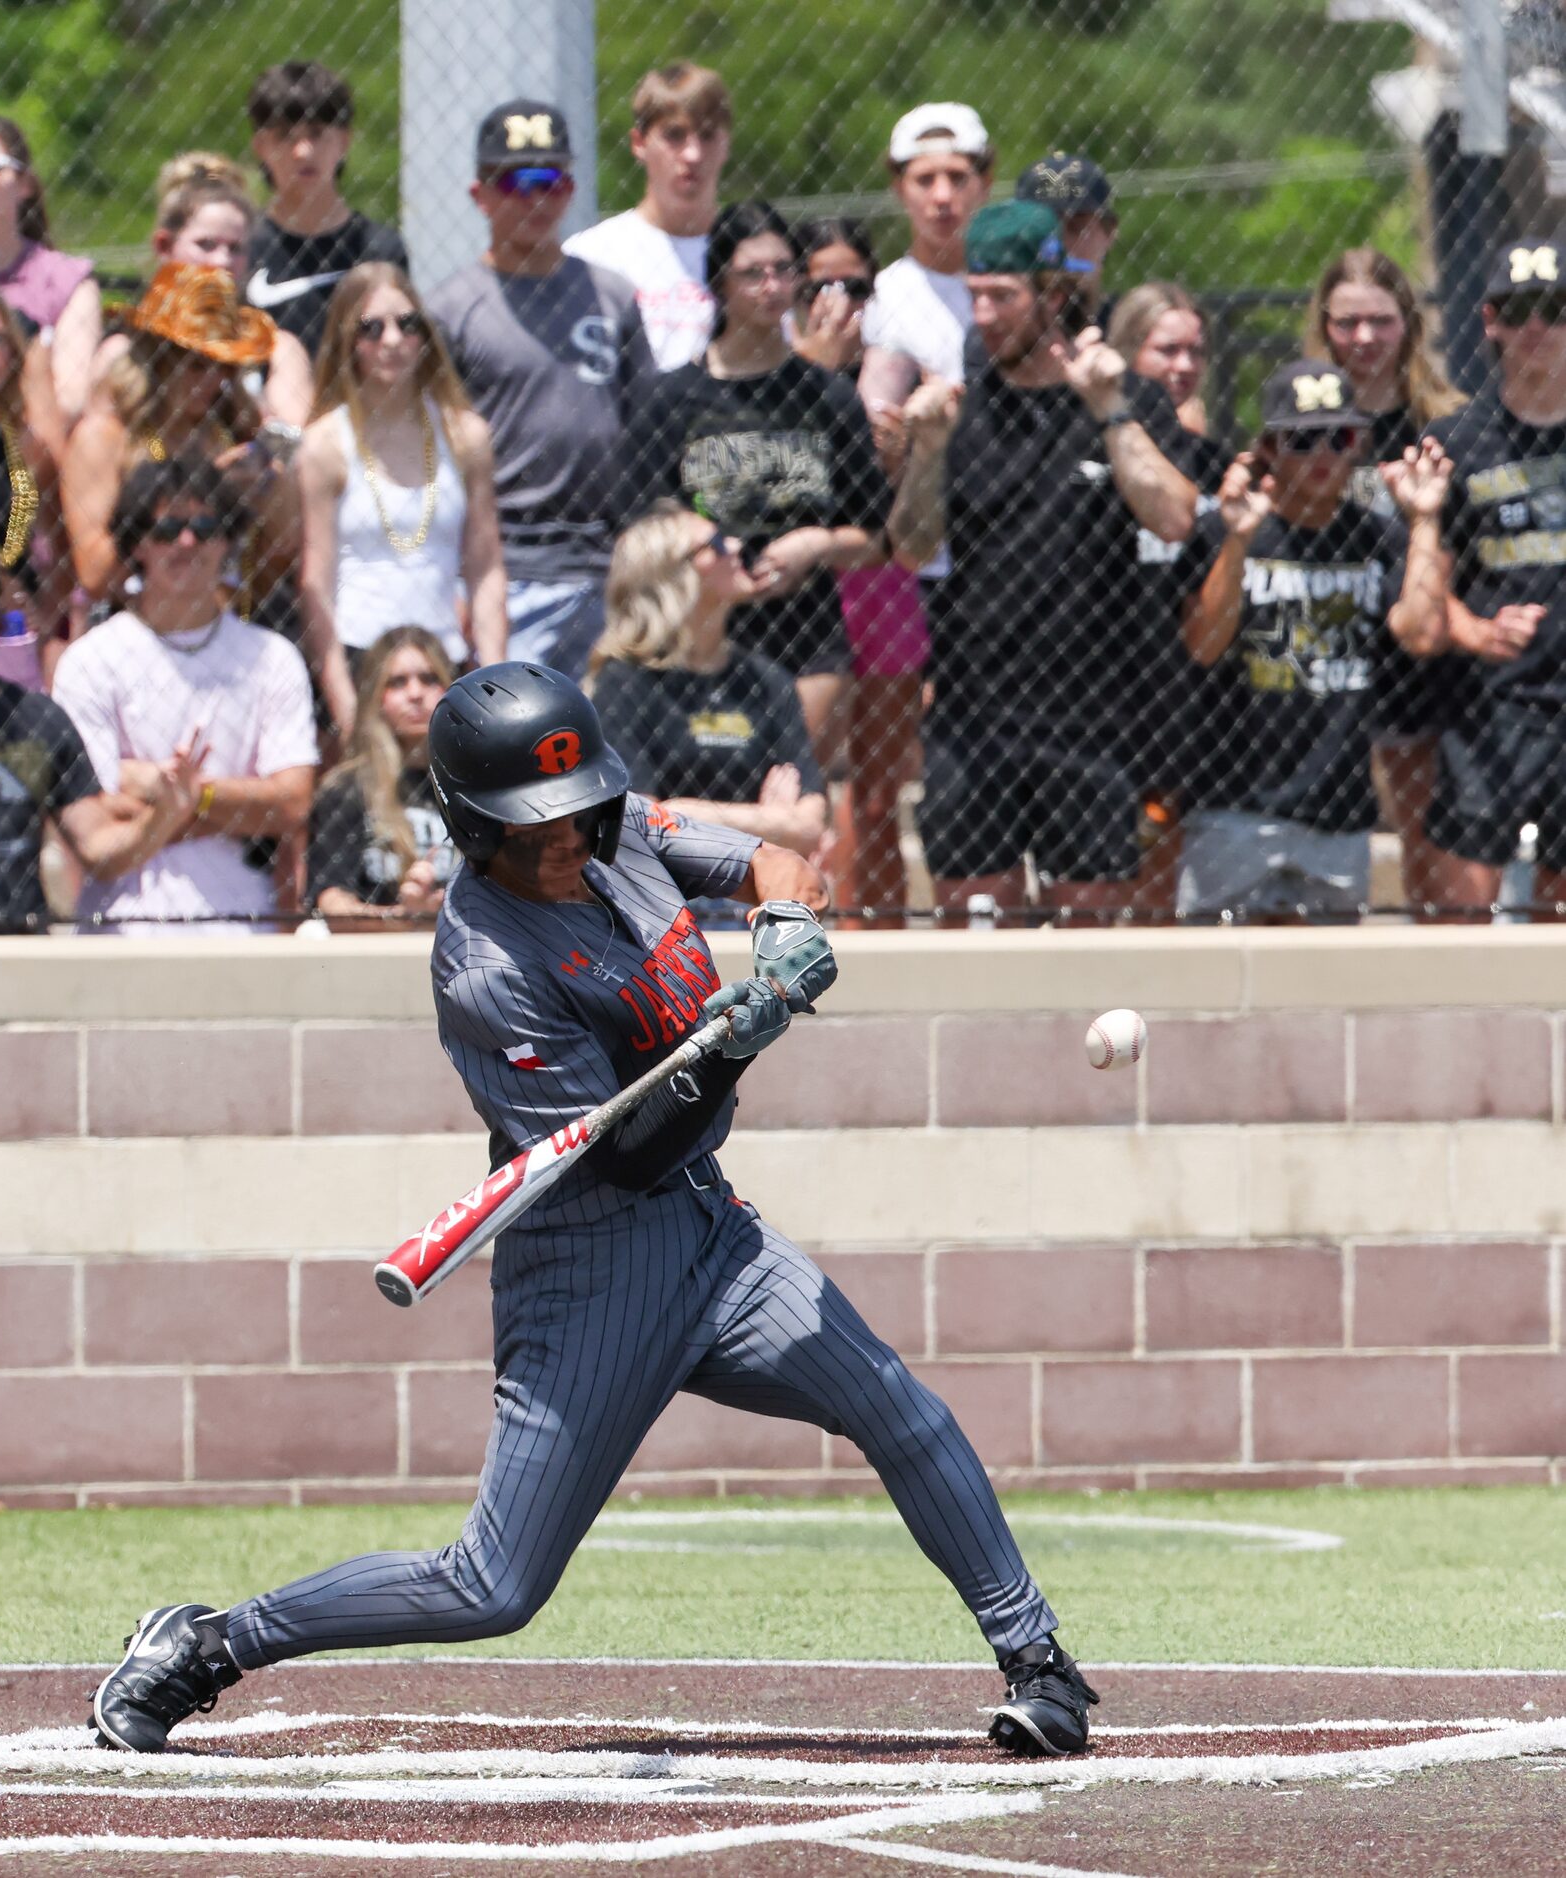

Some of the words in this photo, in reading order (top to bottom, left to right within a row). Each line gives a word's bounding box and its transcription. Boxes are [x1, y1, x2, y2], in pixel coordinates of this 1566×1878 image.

[504, 115, 552, 149] M
[1509, 246, 1558, 283] M
[570, 315, 618, 384] S
[1292, 373, 1342, 412] M
[534, 731, 582, 774] R
[406, 1162, 516, 1266] CATX
